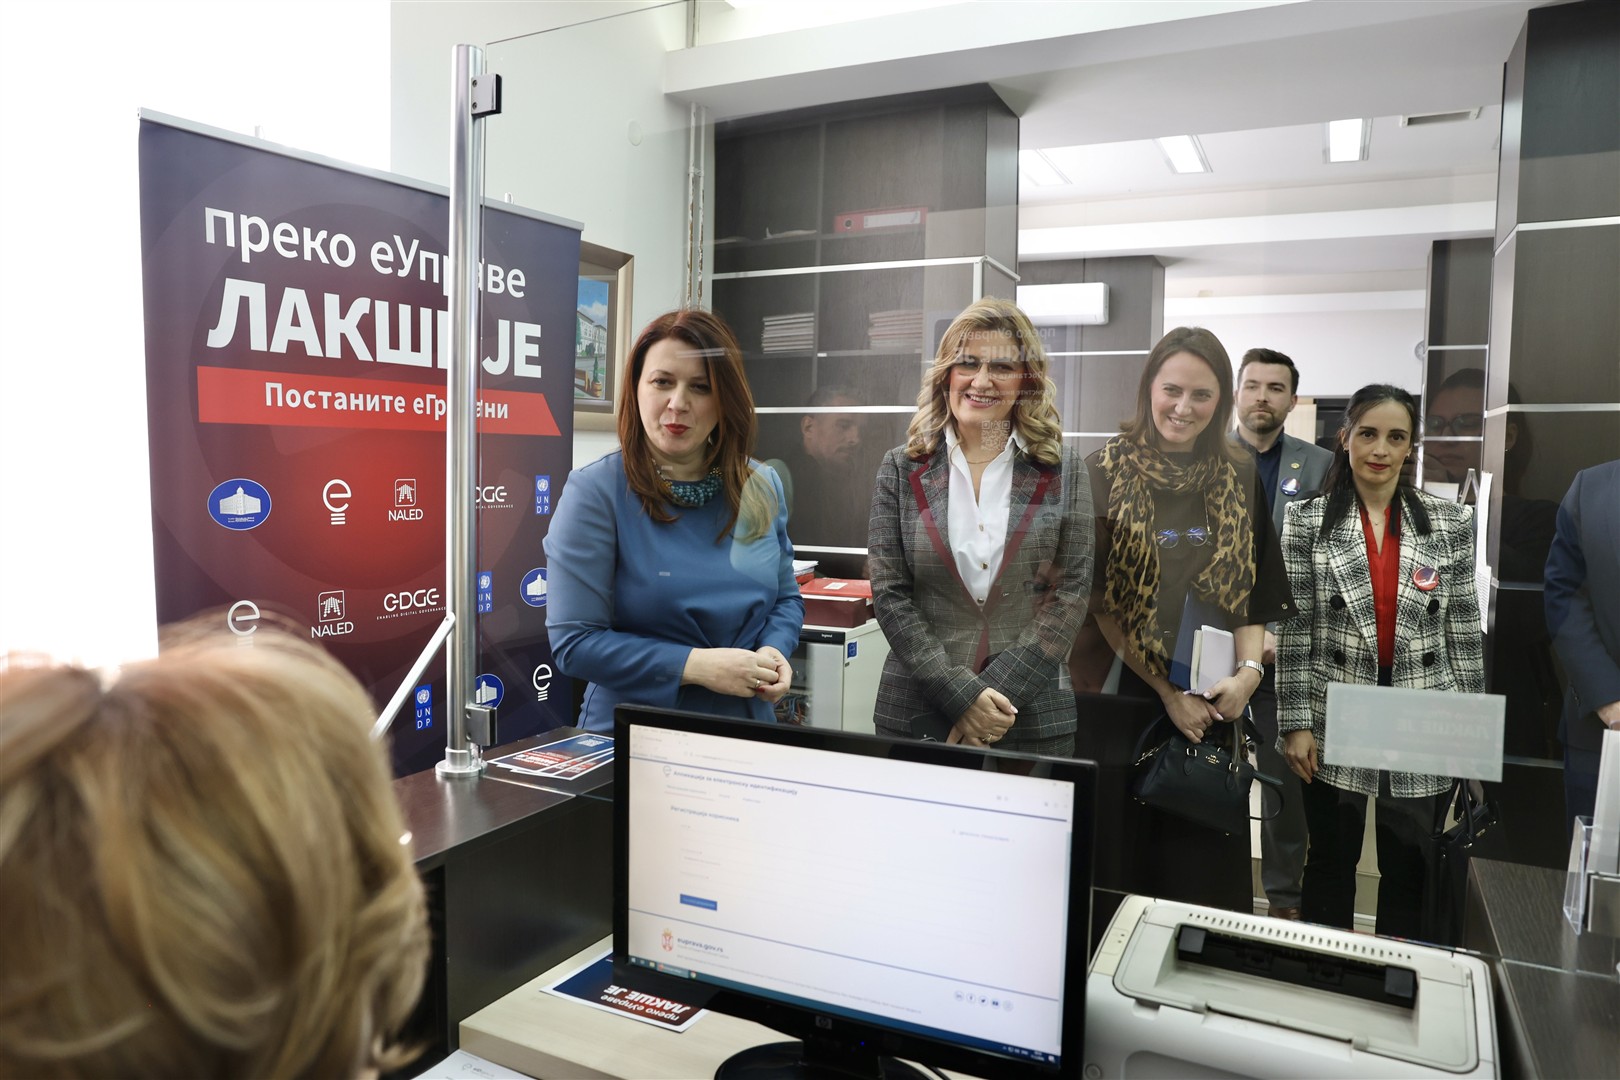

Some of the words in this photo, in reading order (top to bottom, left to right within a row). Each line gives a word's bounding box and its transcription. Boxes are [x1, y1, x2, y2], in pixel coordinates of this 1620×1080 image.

[205, 207, 356, 267] преко
[370, 234, 527, 299] еУпве
[481, 318, 542, 379] ЈЕ
[265, 381, 405, 413] Постаните
[388, 508, 424, 521] NALED
[311, 622, 354, 638] NALED
[603, 984, 628, 996] ЈЕ
[600, 994, 645, 1011] еУправе
[625, 990, 691, 1014] ЛАКШЕ
[645, 1008, 680, 1021] преко
